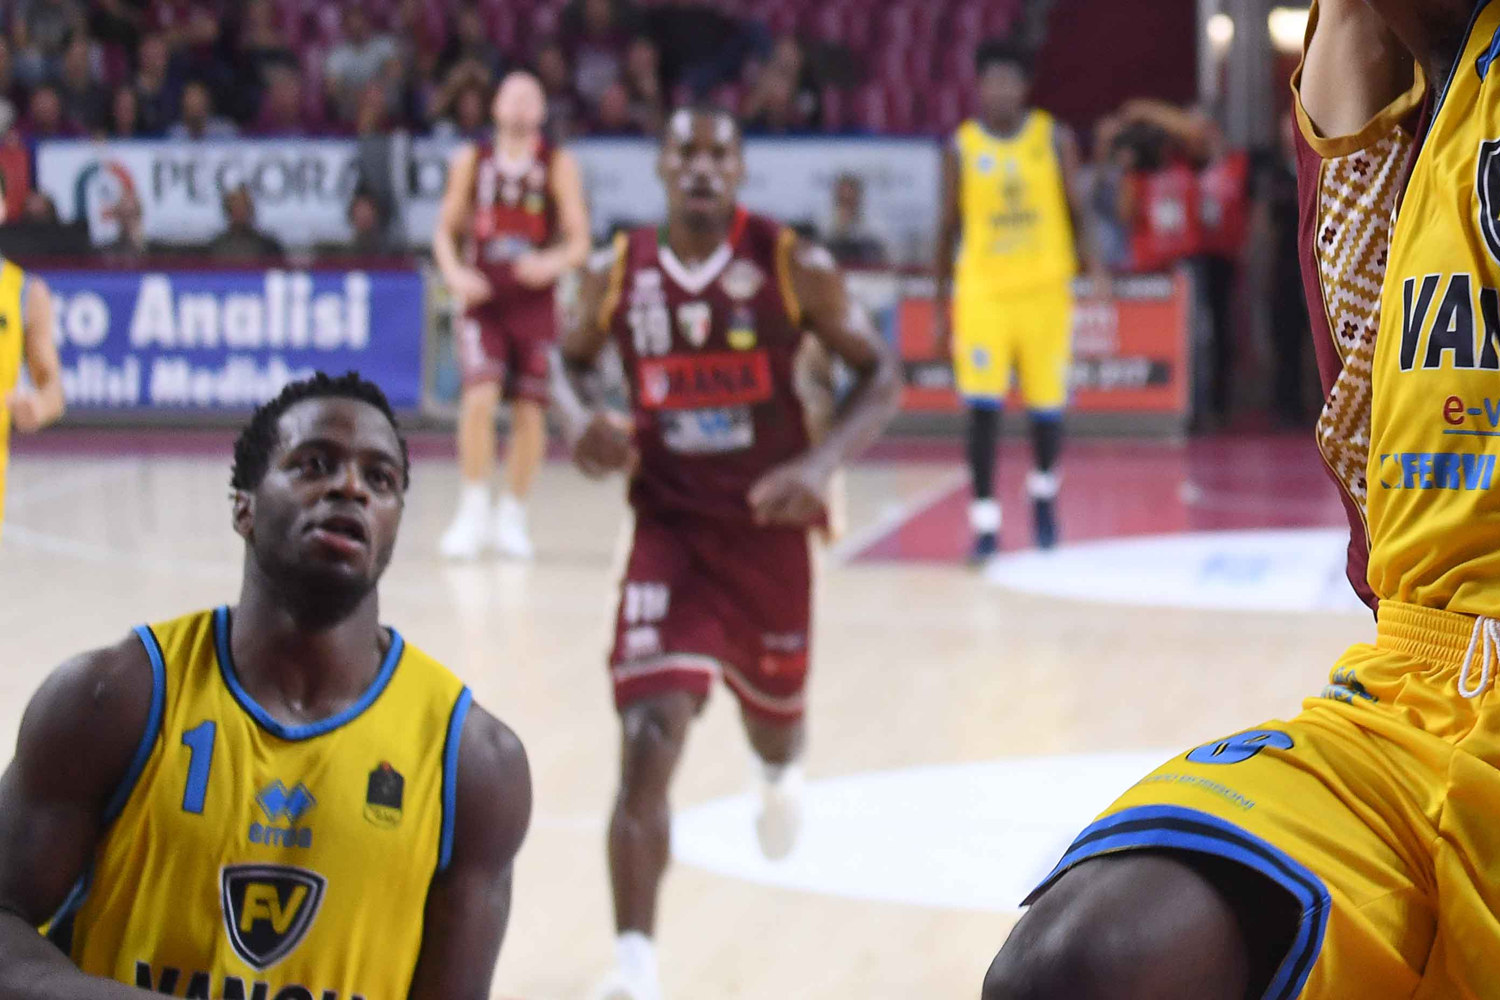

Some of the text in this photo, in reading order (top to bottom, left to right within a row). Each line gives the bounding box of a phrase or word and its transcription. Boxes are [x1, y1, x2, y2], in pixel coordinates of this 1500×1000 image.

[130, 272, 370, 350] Analisi
[1401, 453, 1496, 490] FERVI
[181, 719, 217, 815] 1
